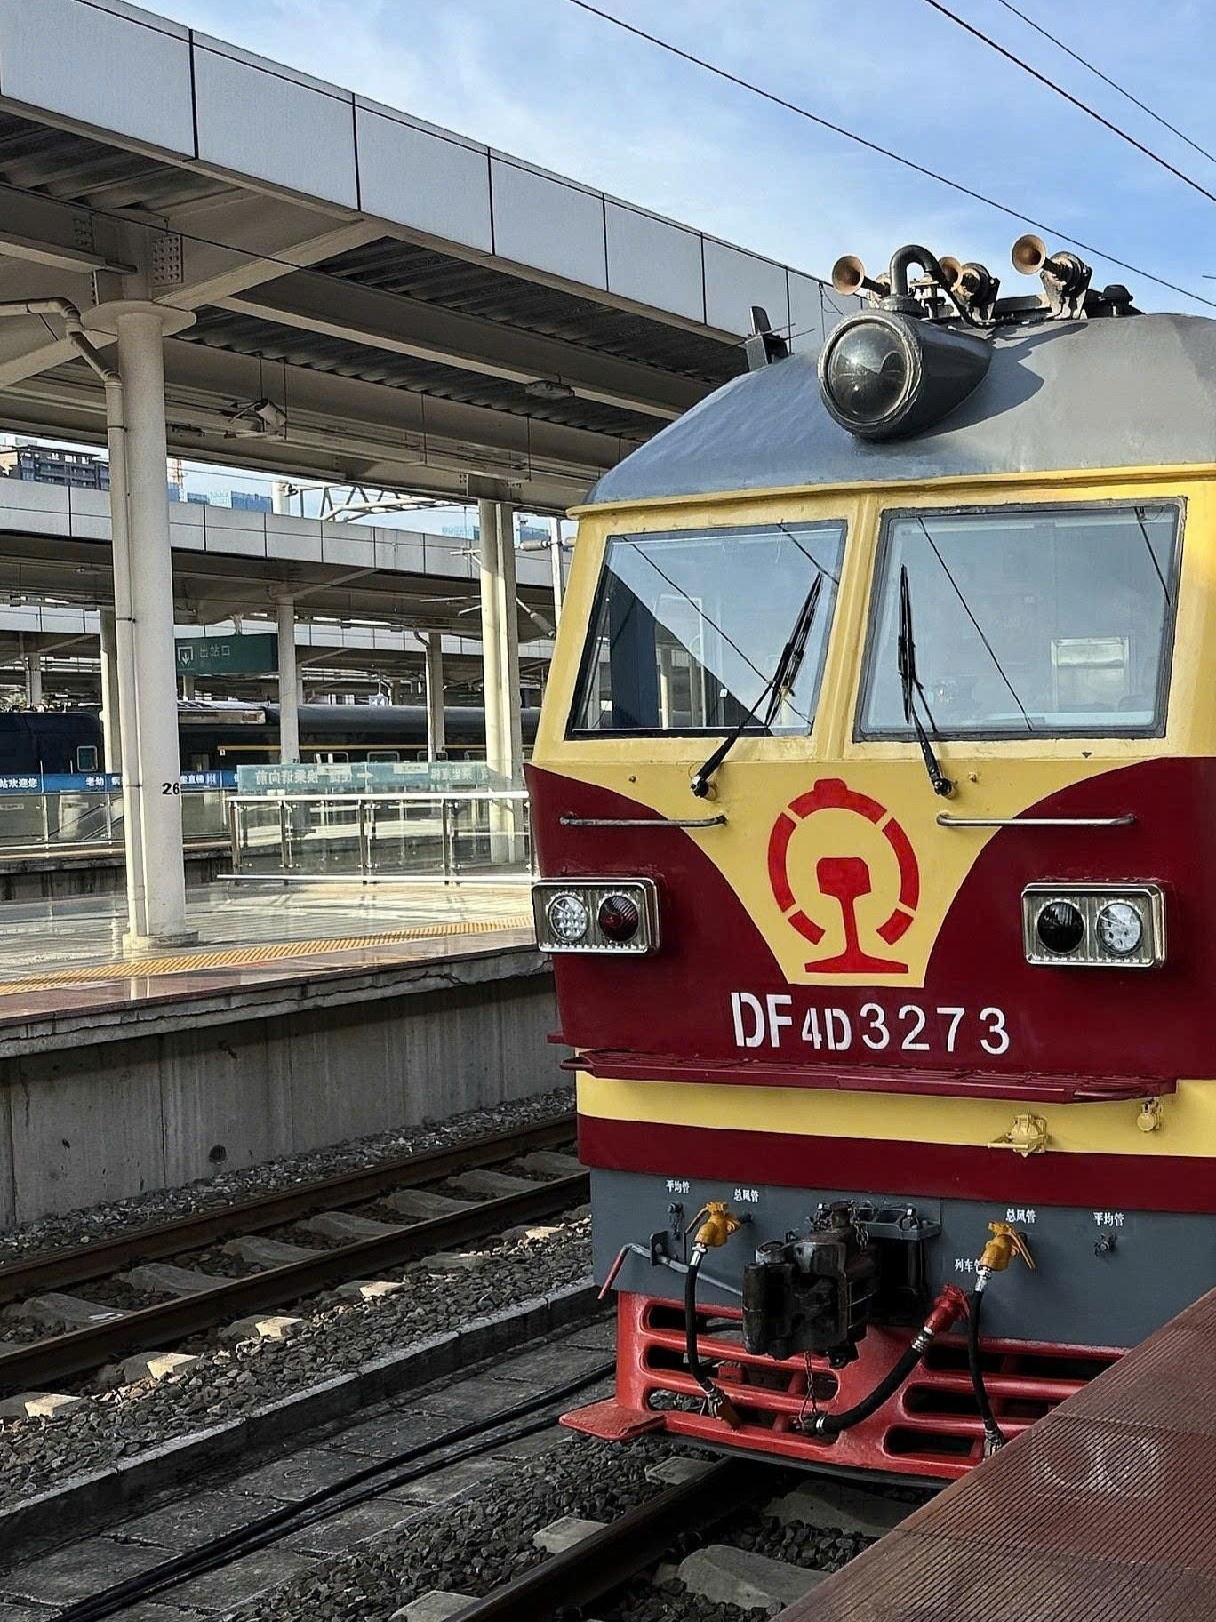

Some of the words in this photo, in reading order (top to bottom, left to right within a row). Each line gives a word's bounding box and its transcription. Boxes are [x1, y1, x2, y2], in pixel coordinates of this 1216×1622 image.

[200, 645, 230, 658] 出站口
[162, 783, 180, 795] 26
[1005, 1209, 1036, 1223] 总风管
[1093, 1212, 1124, 1226] 平均管
